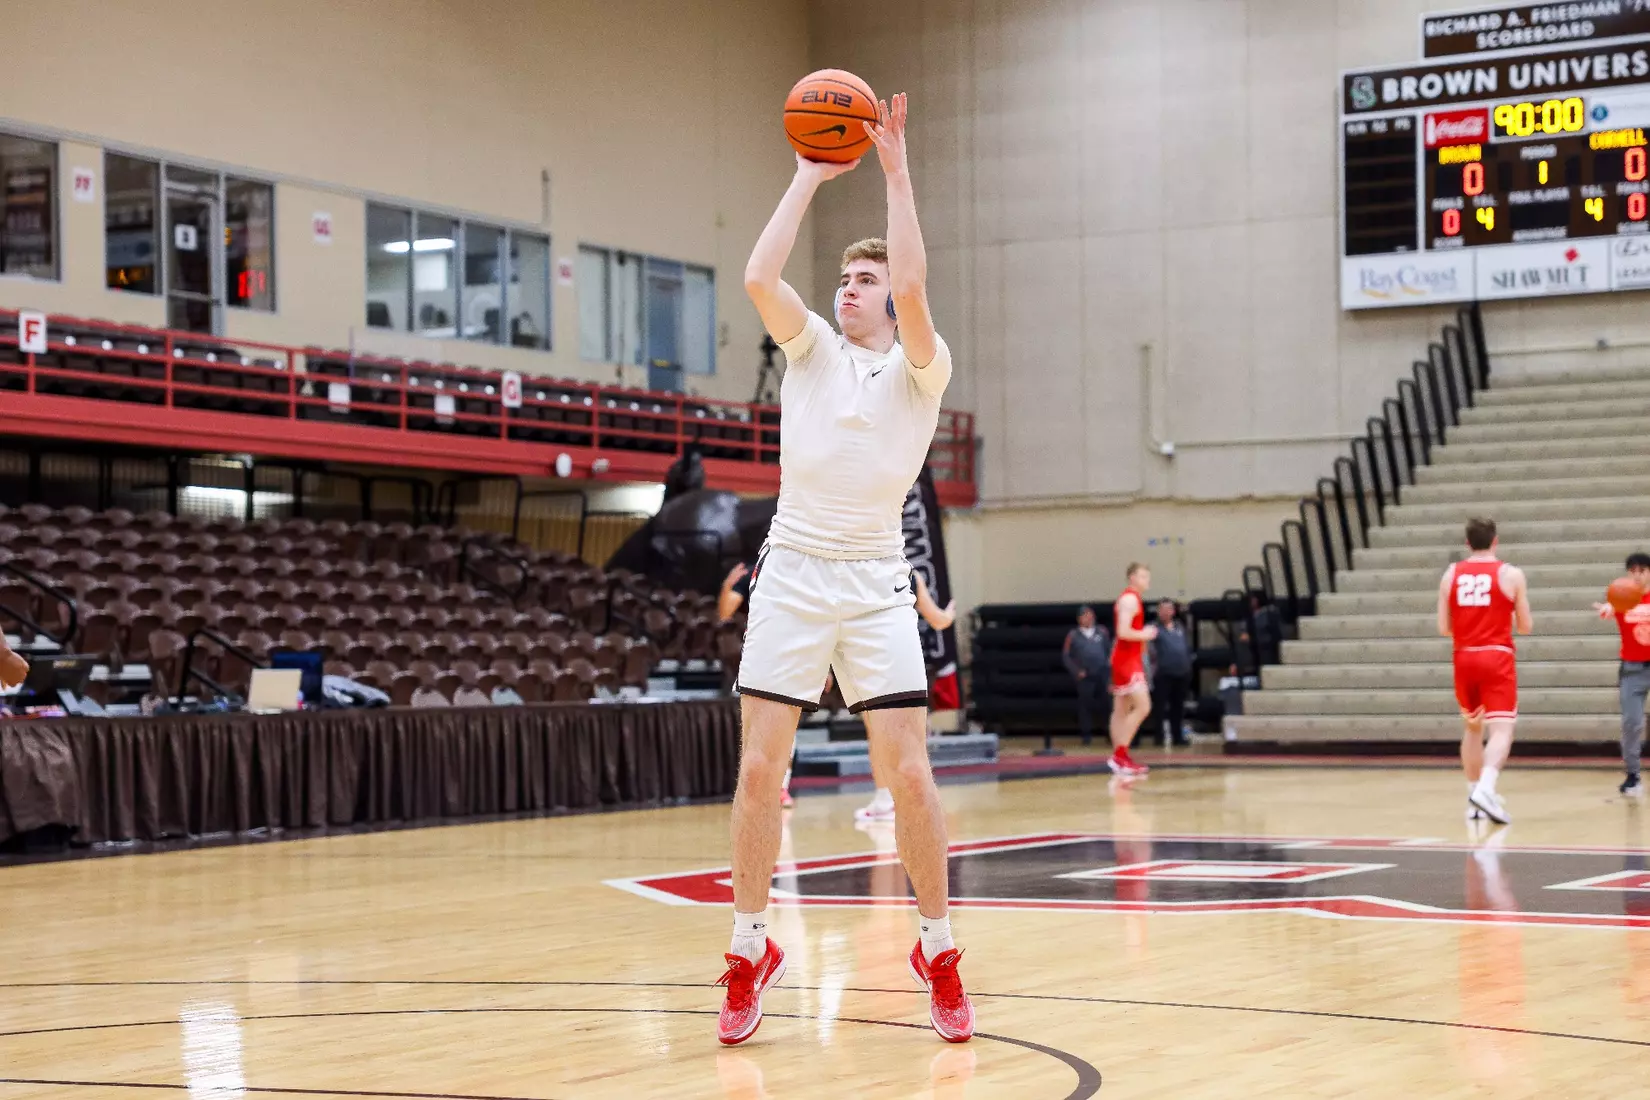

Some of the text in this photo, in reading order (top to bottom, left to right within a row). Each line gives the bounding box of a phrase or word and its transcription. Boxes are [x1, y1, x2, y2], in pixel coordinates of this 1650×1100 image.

[1425, 14, 1502, 37] RICHARD
[1506, 11, 1526, 27] A.
[1530, 0, 1620, 23] FRIEDMAN
[1476, 20, 1595, 50] SCOREBOARD
[1382, 66, 1498, 103] BROWN
[1508, 49, 1650, 90] UNIVERS
[801, 90, 852, 109] ELITE
[1493, 97, 1584, 137] 90:00
[1538, 160, 1549, 185] 1
[1624, 146, 1646, 182] 0
[1462, 162, 1484, 196] 0
[1476, 206, 1495, 231] 4
[1584, 197, 1604, 222] 4
[1627, 192, 1647, 221] 0
[1442, 208, 1461, 236] 0
[24, 319, 41, 344] F
[1456, 573, 1493, 607] 22
